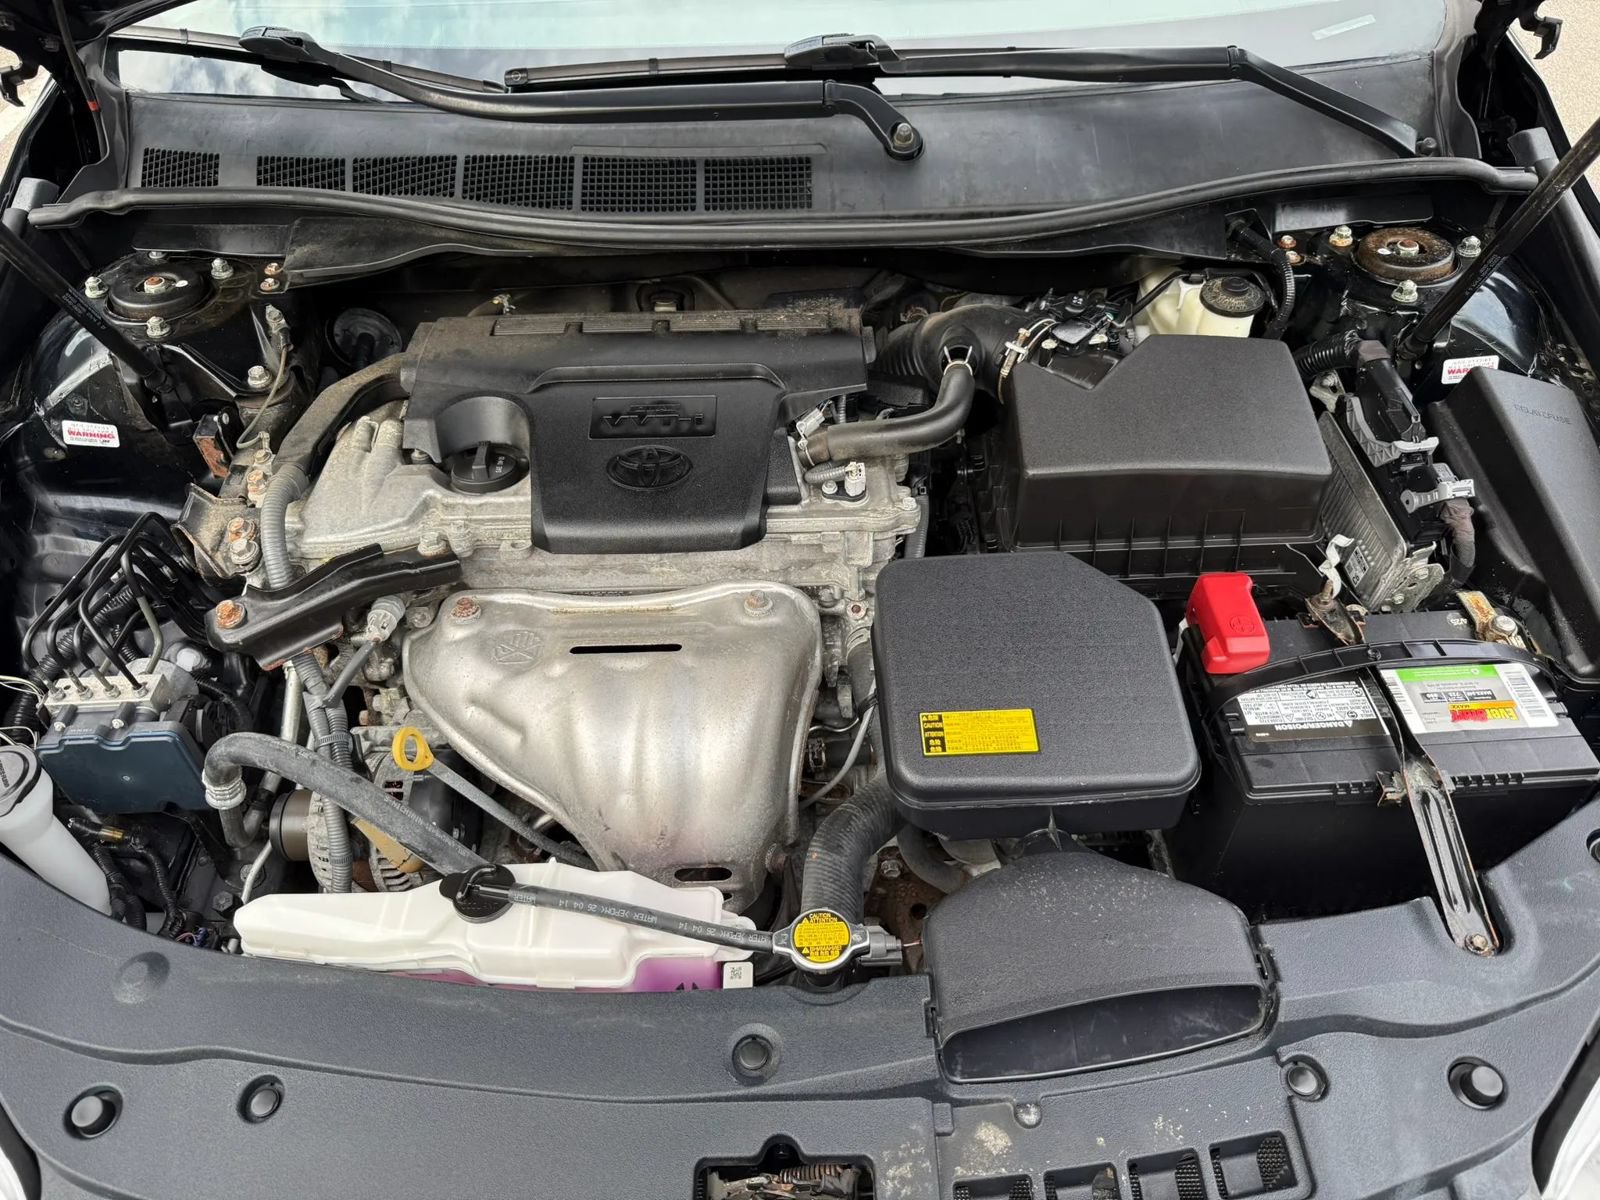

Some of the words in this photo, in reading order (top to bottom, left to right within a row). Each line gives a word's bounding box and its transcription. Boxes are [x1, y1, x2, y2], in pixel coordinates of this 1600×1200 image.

[67, 429, 115, 439] WARNING
[559, 898, 569, 907] 14
[573, 901, 584, 910] 04
[587, 902, 598, 912] 26
[633, 911, 658, 925] WATER
[678, 921, 689, 930] 14
[691, 924, 703, 933] 04
[704, 926, 715, 936] 26
